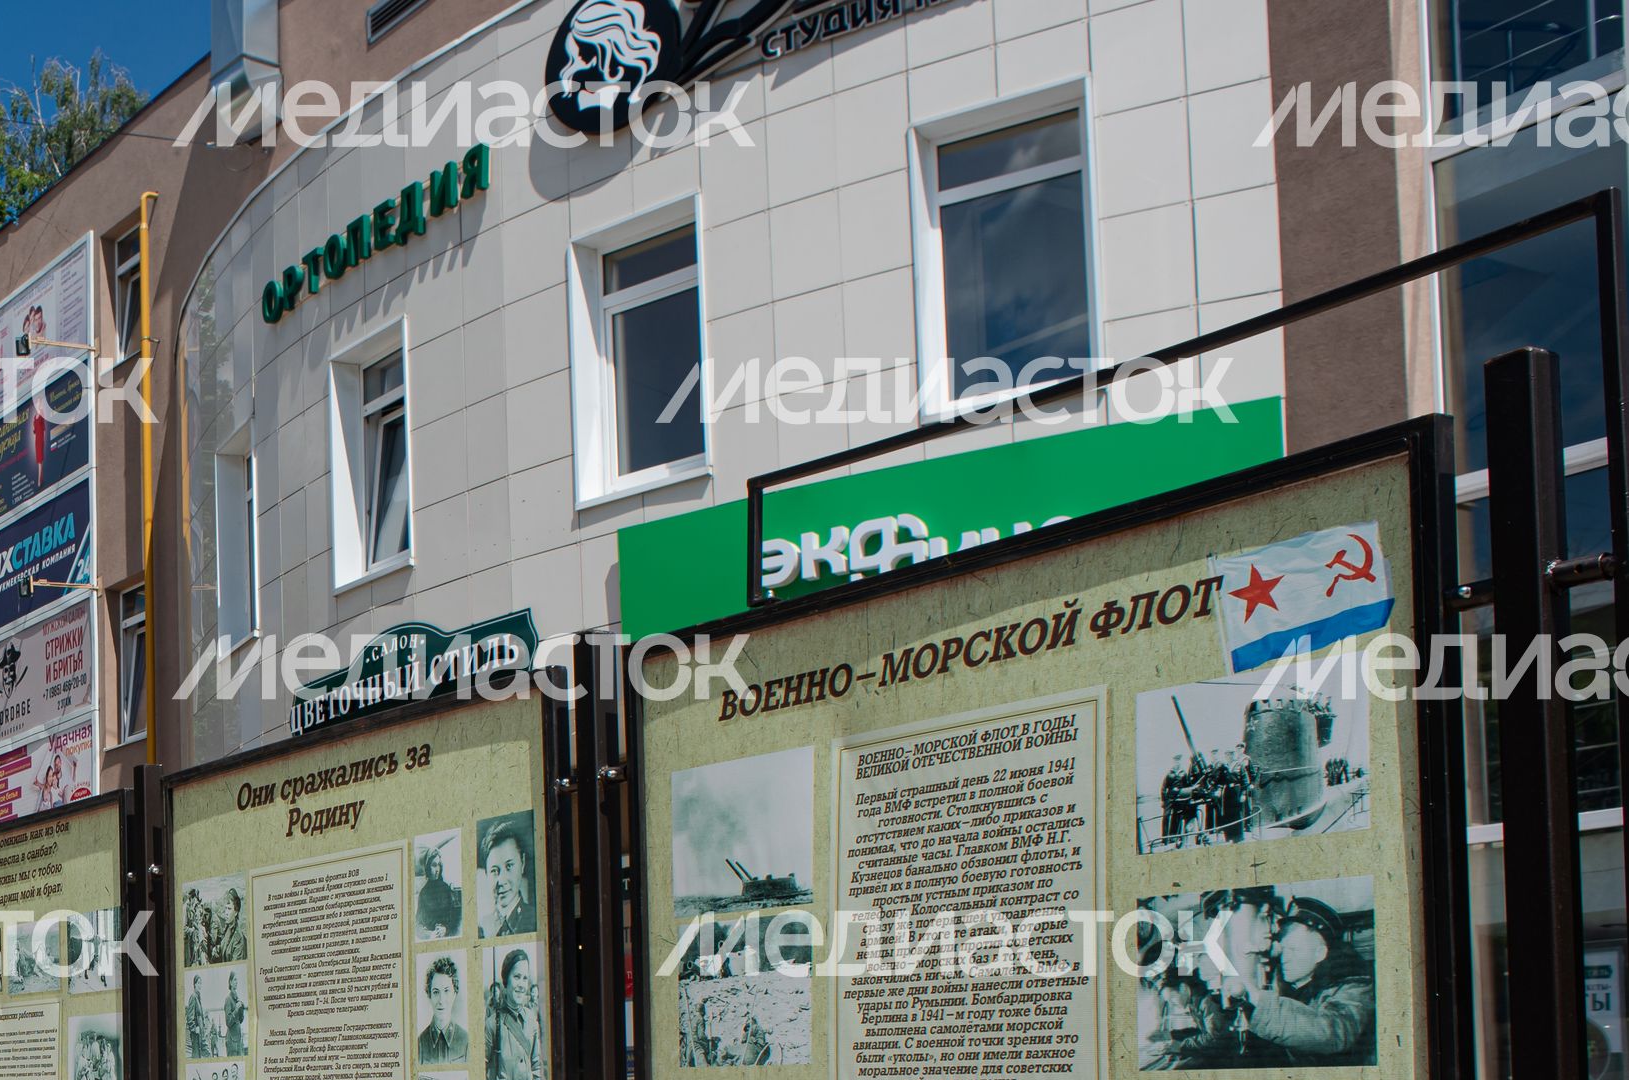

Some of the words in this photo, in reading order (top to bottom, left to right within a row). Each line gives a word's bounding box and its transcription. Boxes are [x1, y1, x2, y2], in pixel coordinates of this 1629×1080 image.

[261, 143, 491, 325] ОРТОПЕДИЯ
[41, 543, 75, 570] КОМПАНИЯ
[1089, 573, 1224, 640] ФЛОТ
[45, 625, 82, 661] СТРИЖКИ
[369, 633, 420, 663] САЛОН
[45, 664, 51, 684] И
[53, 649, 82, 681] БРИТЬЯ
[290, 656, 422, 737] ЦВЕТОЧНЫЙ
[430, 630, 521, 688] СТИЛЬ
[48, 719, 91, 755] Удачная
[980, 724, 1019, 743] ФЛОТ
[1021, 722, 1030, 735] В
[1032, 713, 1076, 735] ГОДЫ
[855, 756, 910, 780] ВЕЛИКОЙ
[912, 736, 1022, 769] ОТЕЧЕСТВЕННОЙ
[1024, 725, 1078, 750] ВОЙНЫ
[236, 774, 276, 812] Они
[280, 750, 398, 807] сражались
[403, 740, 431, 772] за
[855, 787, 897, 807] Первый
[900, 776, 959, 800] страшный
[960, 773, 989, 789] день
[992, 768, 1007, 782] 22
[1009, 765, 1044, 780] июня
[1047, 756, 1075, 773] 1941
[857, 806, 881, 819] года
[884, 798, 911, 813] ВМФ
[913, 791, 967, 811] встретил
[969, 790, 975, 800] в
[978, 780, 1024, 799] полной
[1027, 771, 1074, 791] боевой
[877, 809, 942, 828] готовности.
[946, 791, 1036, 821] Столкнувшись
[1039, 793, 1048, 803] с
[30, 828, 43, 841] как
[45, 826, 54, 836] из
[55, 820, 69, 834] боя
[285, 790, 365, 843] Родину
[855, 825, 924, 846] отсутствием
[1002, 804, 1063, 824] приказов
[1066, 802, 1076, 813] и
[26, 840, 58, 861] санбат?
[847, 842, 896, 860] понимая,
[900, 839, 918, 850] что
[921, 837, 935, 849] до
[937, 830, 979, 845] начала
[982, 821, 1022, 839] войны
[1025, 816, 1085, 834] остались
[858, 852, 918, 870] считанные
[921, 848, 952, 860] часы.
[956, 837, 1007, 857] Главком
[1010, 832, 1043, 849] ВМФ
[1046, 829, 1071, 845] Н.Г.
[18, 870, 29, 880] мы
[37, 860, 62, 876] тобою
[347, 867, 359, 877] ВОВ
[850, 865, 902, 885] Кузнецов
[904, 858, 957, 877] банально
[960, 850, 1017, 870] обзвонил
[1020, 844, 1067, 865] флоты,
[1071, 846, 1081, 856] и
[889, 881, 903, 892] их
[905, 881, 911, 890] в
[913, 874, 958, 891] полную
[961, 865, 1006, 885] боевую
[1009, 859, 1082, 878] готовность
[20, 884, 35, 899] мой
[872, 891, 922, 909] простым
[925, 886, 970, 903] устным
[972, 879, 1034, 897] приказом
[1036, 877, 1053, 888] по
